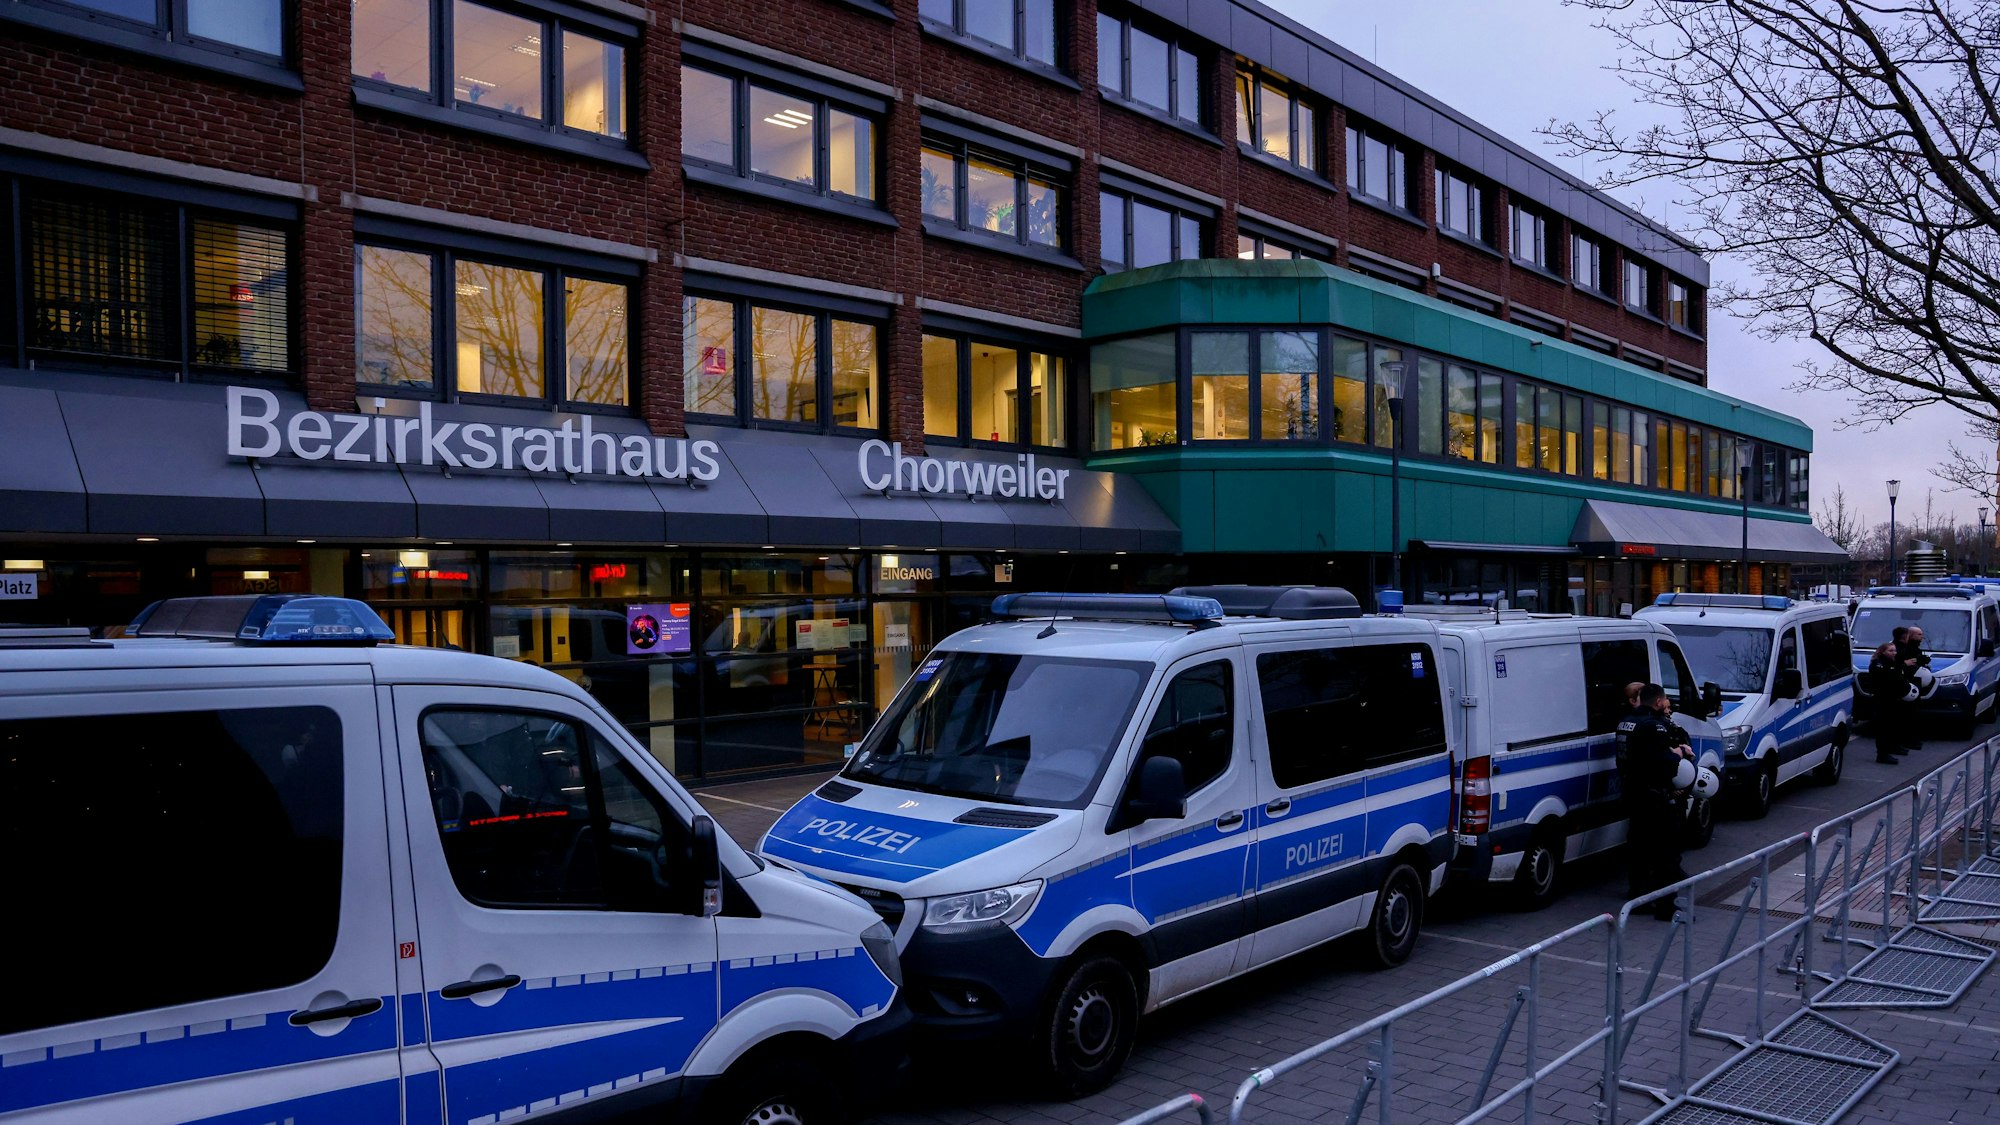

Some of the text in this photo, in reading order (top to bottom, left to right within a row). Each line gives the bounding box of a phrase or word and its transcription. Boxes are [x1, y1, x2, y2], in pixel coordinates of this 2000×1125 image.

[226, 385, 1069, 499] Bezirksrathaus Chorweiler
[880, 567, 933, 580] EINGANG
[925, 659, 944, 668] NRW
[798, 818, 922, 854] POLIZEI
[1286, 833, 1343, 870] POLIZEI
